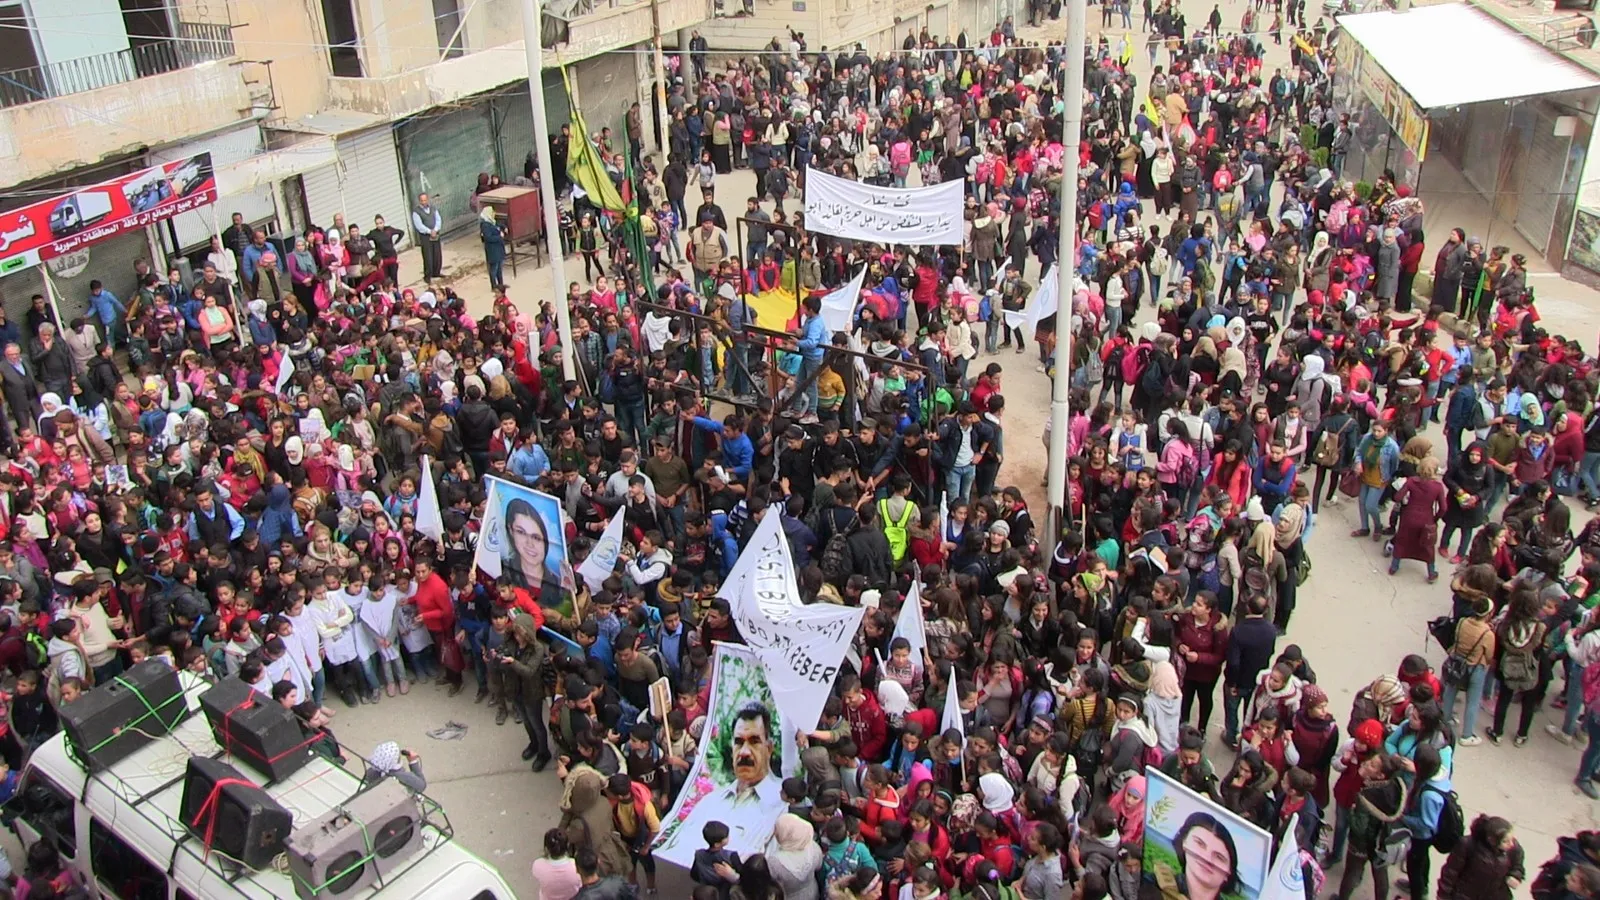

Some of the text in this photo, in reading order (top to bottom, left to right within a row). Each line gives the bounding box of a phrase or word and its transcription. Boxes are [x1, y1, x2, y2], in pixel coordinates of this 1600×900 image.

[176, 200, 192, 212] جميع
[193, 192, 208, 206] شحن
[864, 194, 911, 208] تحت شعار
[152, 205, 176, 221] البضائع
[122, 216, 139, 228] كافة
[82, 223, 119, 242] المحافظات
[52, 236, 81, 253] السورية
